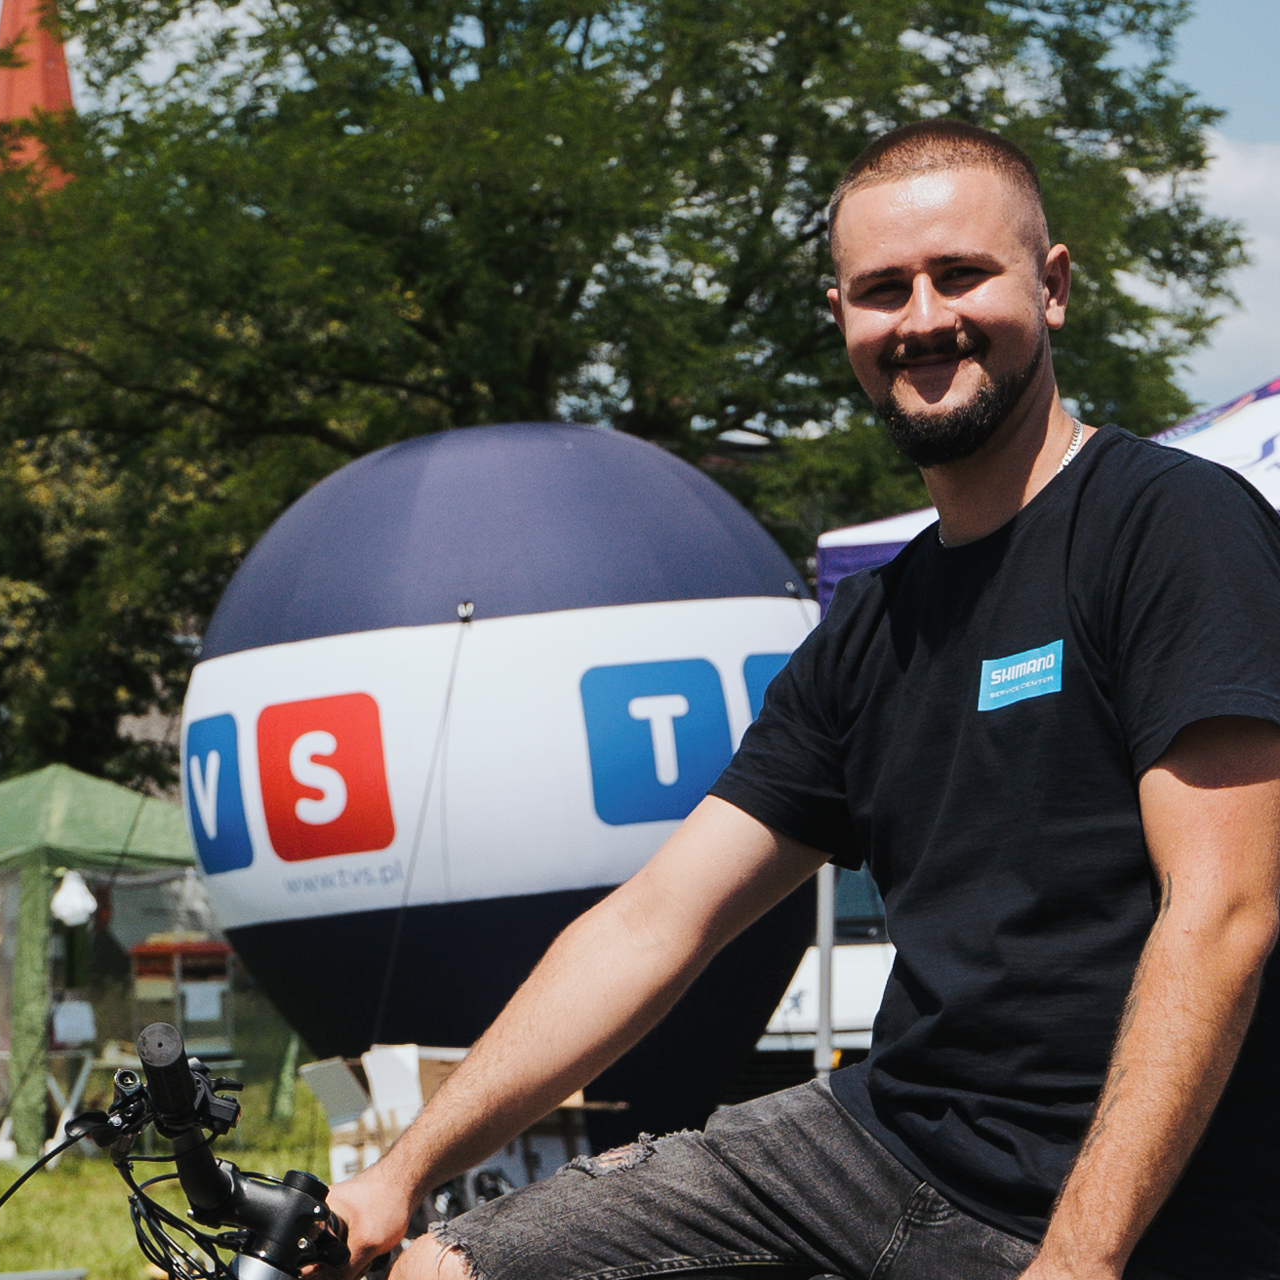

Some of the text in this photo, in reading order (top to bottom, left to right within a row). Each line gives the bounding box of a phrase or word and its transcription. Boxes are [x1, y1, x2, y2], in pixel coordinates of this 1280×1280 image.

[990, 653, 1055, 685] SHIMANO
[989, 675, 1054, 699] SERVICE CENTER
